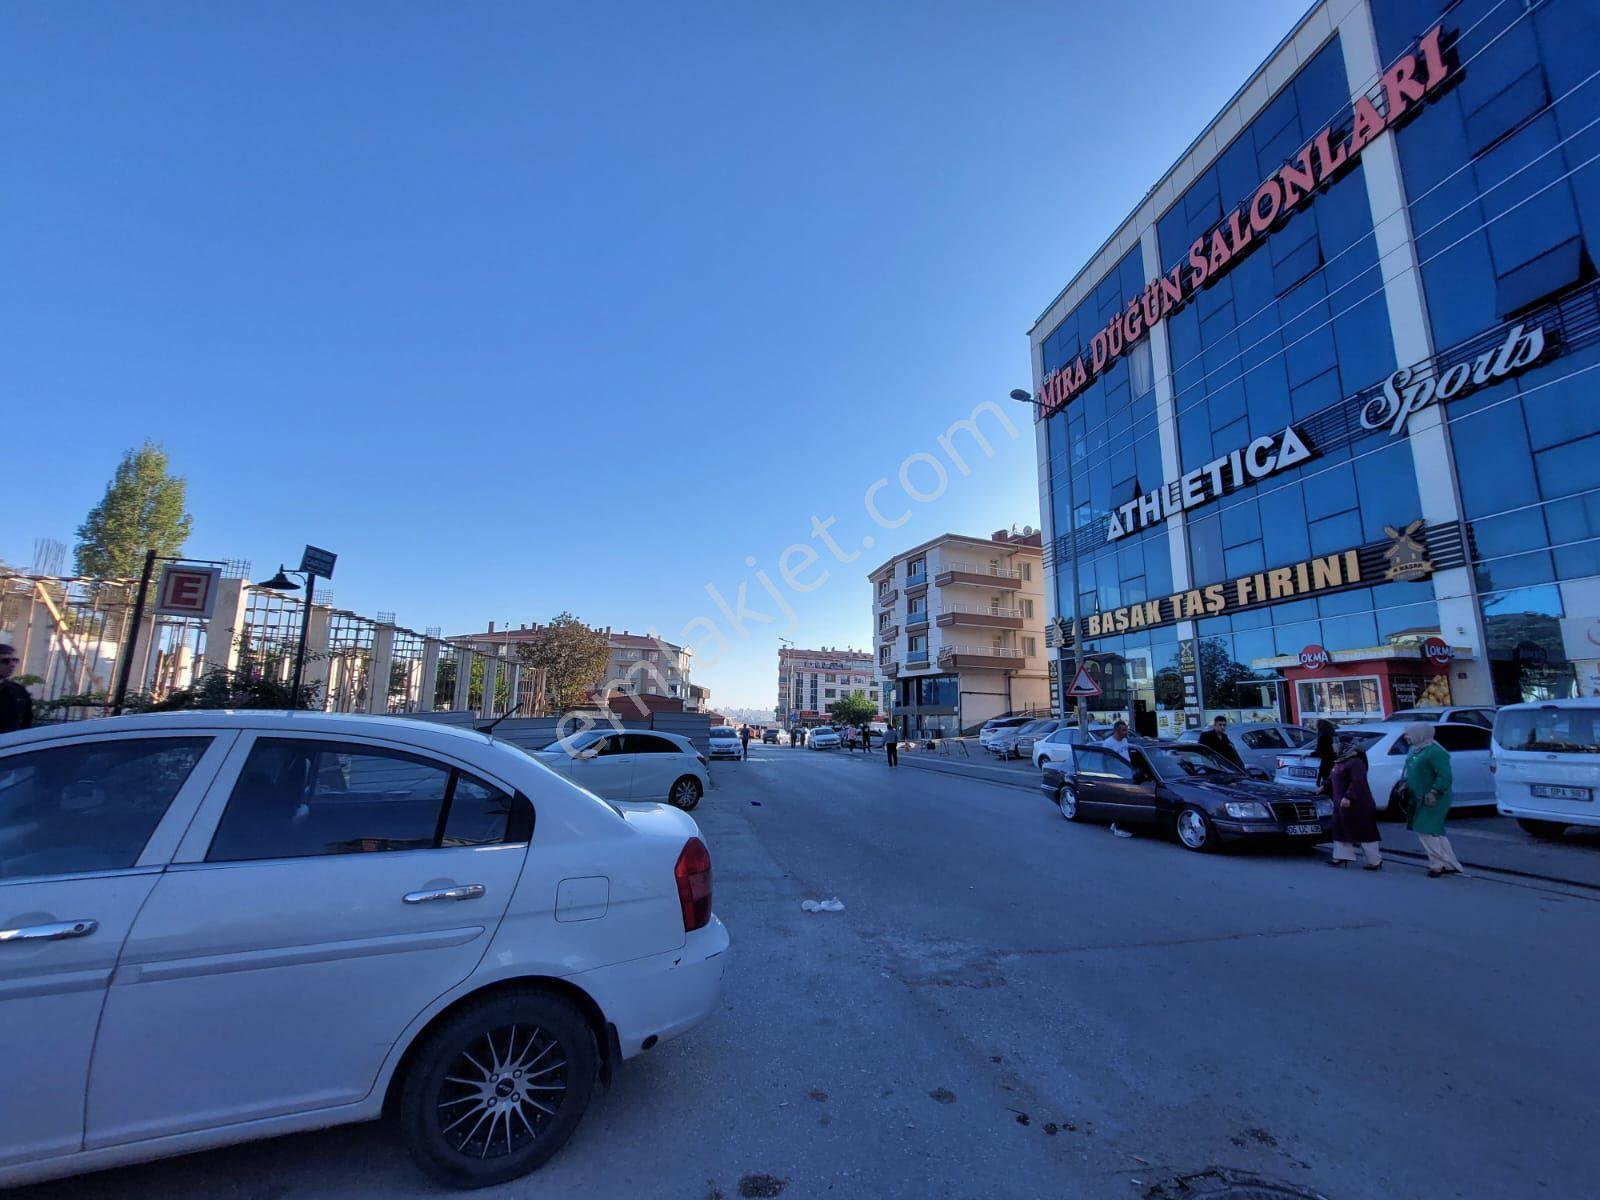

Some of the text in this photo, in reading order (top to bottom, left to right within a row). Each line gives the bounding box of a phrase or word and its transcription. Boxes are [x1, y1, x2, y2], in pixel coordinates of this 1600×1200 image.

[1038, 24, 1450, 418] MİRA DÜĞÜN SALONLARI
[1360, 321, 1548, 436] Sports
[1106, 425, 1313, 542] ATHLETICA
[171, 575, 202, 606] E
[1088, 600, 1162, 637] BAŞAK
[1168, 584, 1225, 617] TAŞ
[1236, 550, 1361, 607] FIRINI
[1298, 650, 1329, 664] LOKMA
[1425, 644, 1455, 658] LOKMA
